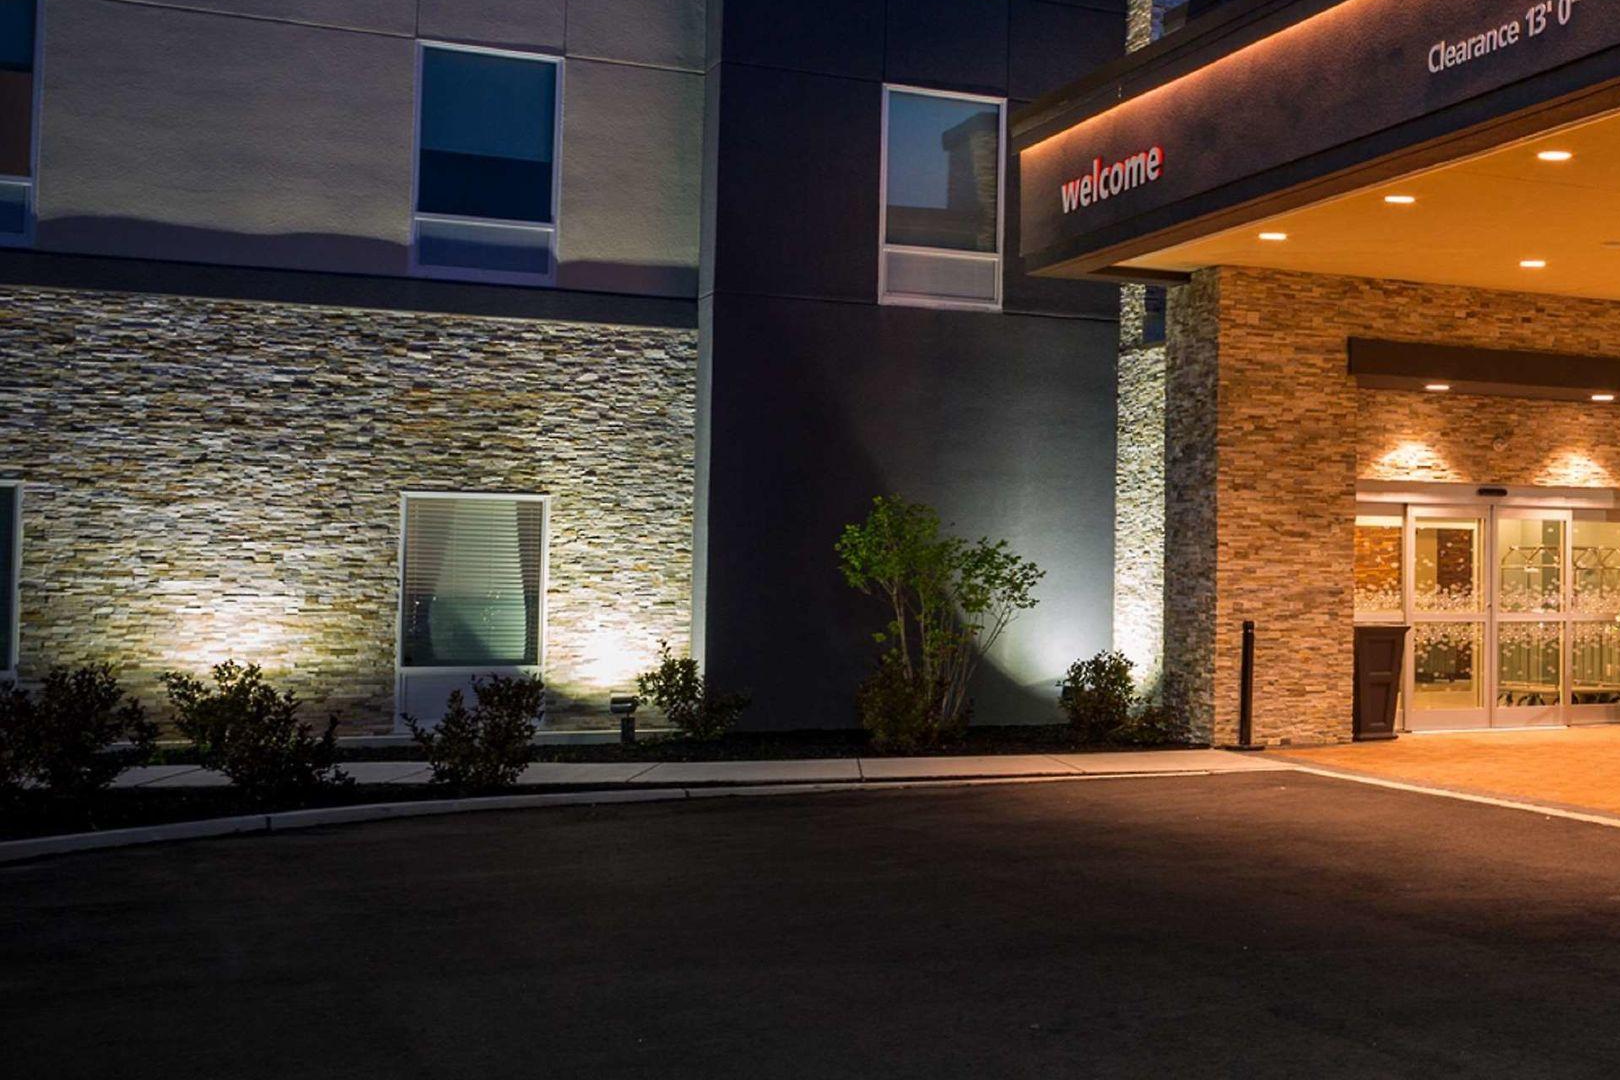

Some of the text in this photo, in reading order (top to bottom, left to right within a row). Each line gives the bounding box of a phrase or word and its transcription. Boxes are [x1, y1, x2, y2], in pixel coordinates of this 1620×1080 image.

[1427, 20, 1520, 74] Clearance
[1525, 0, 1553, 38] 13'
[1061, 145, 1164, 214] welcome
